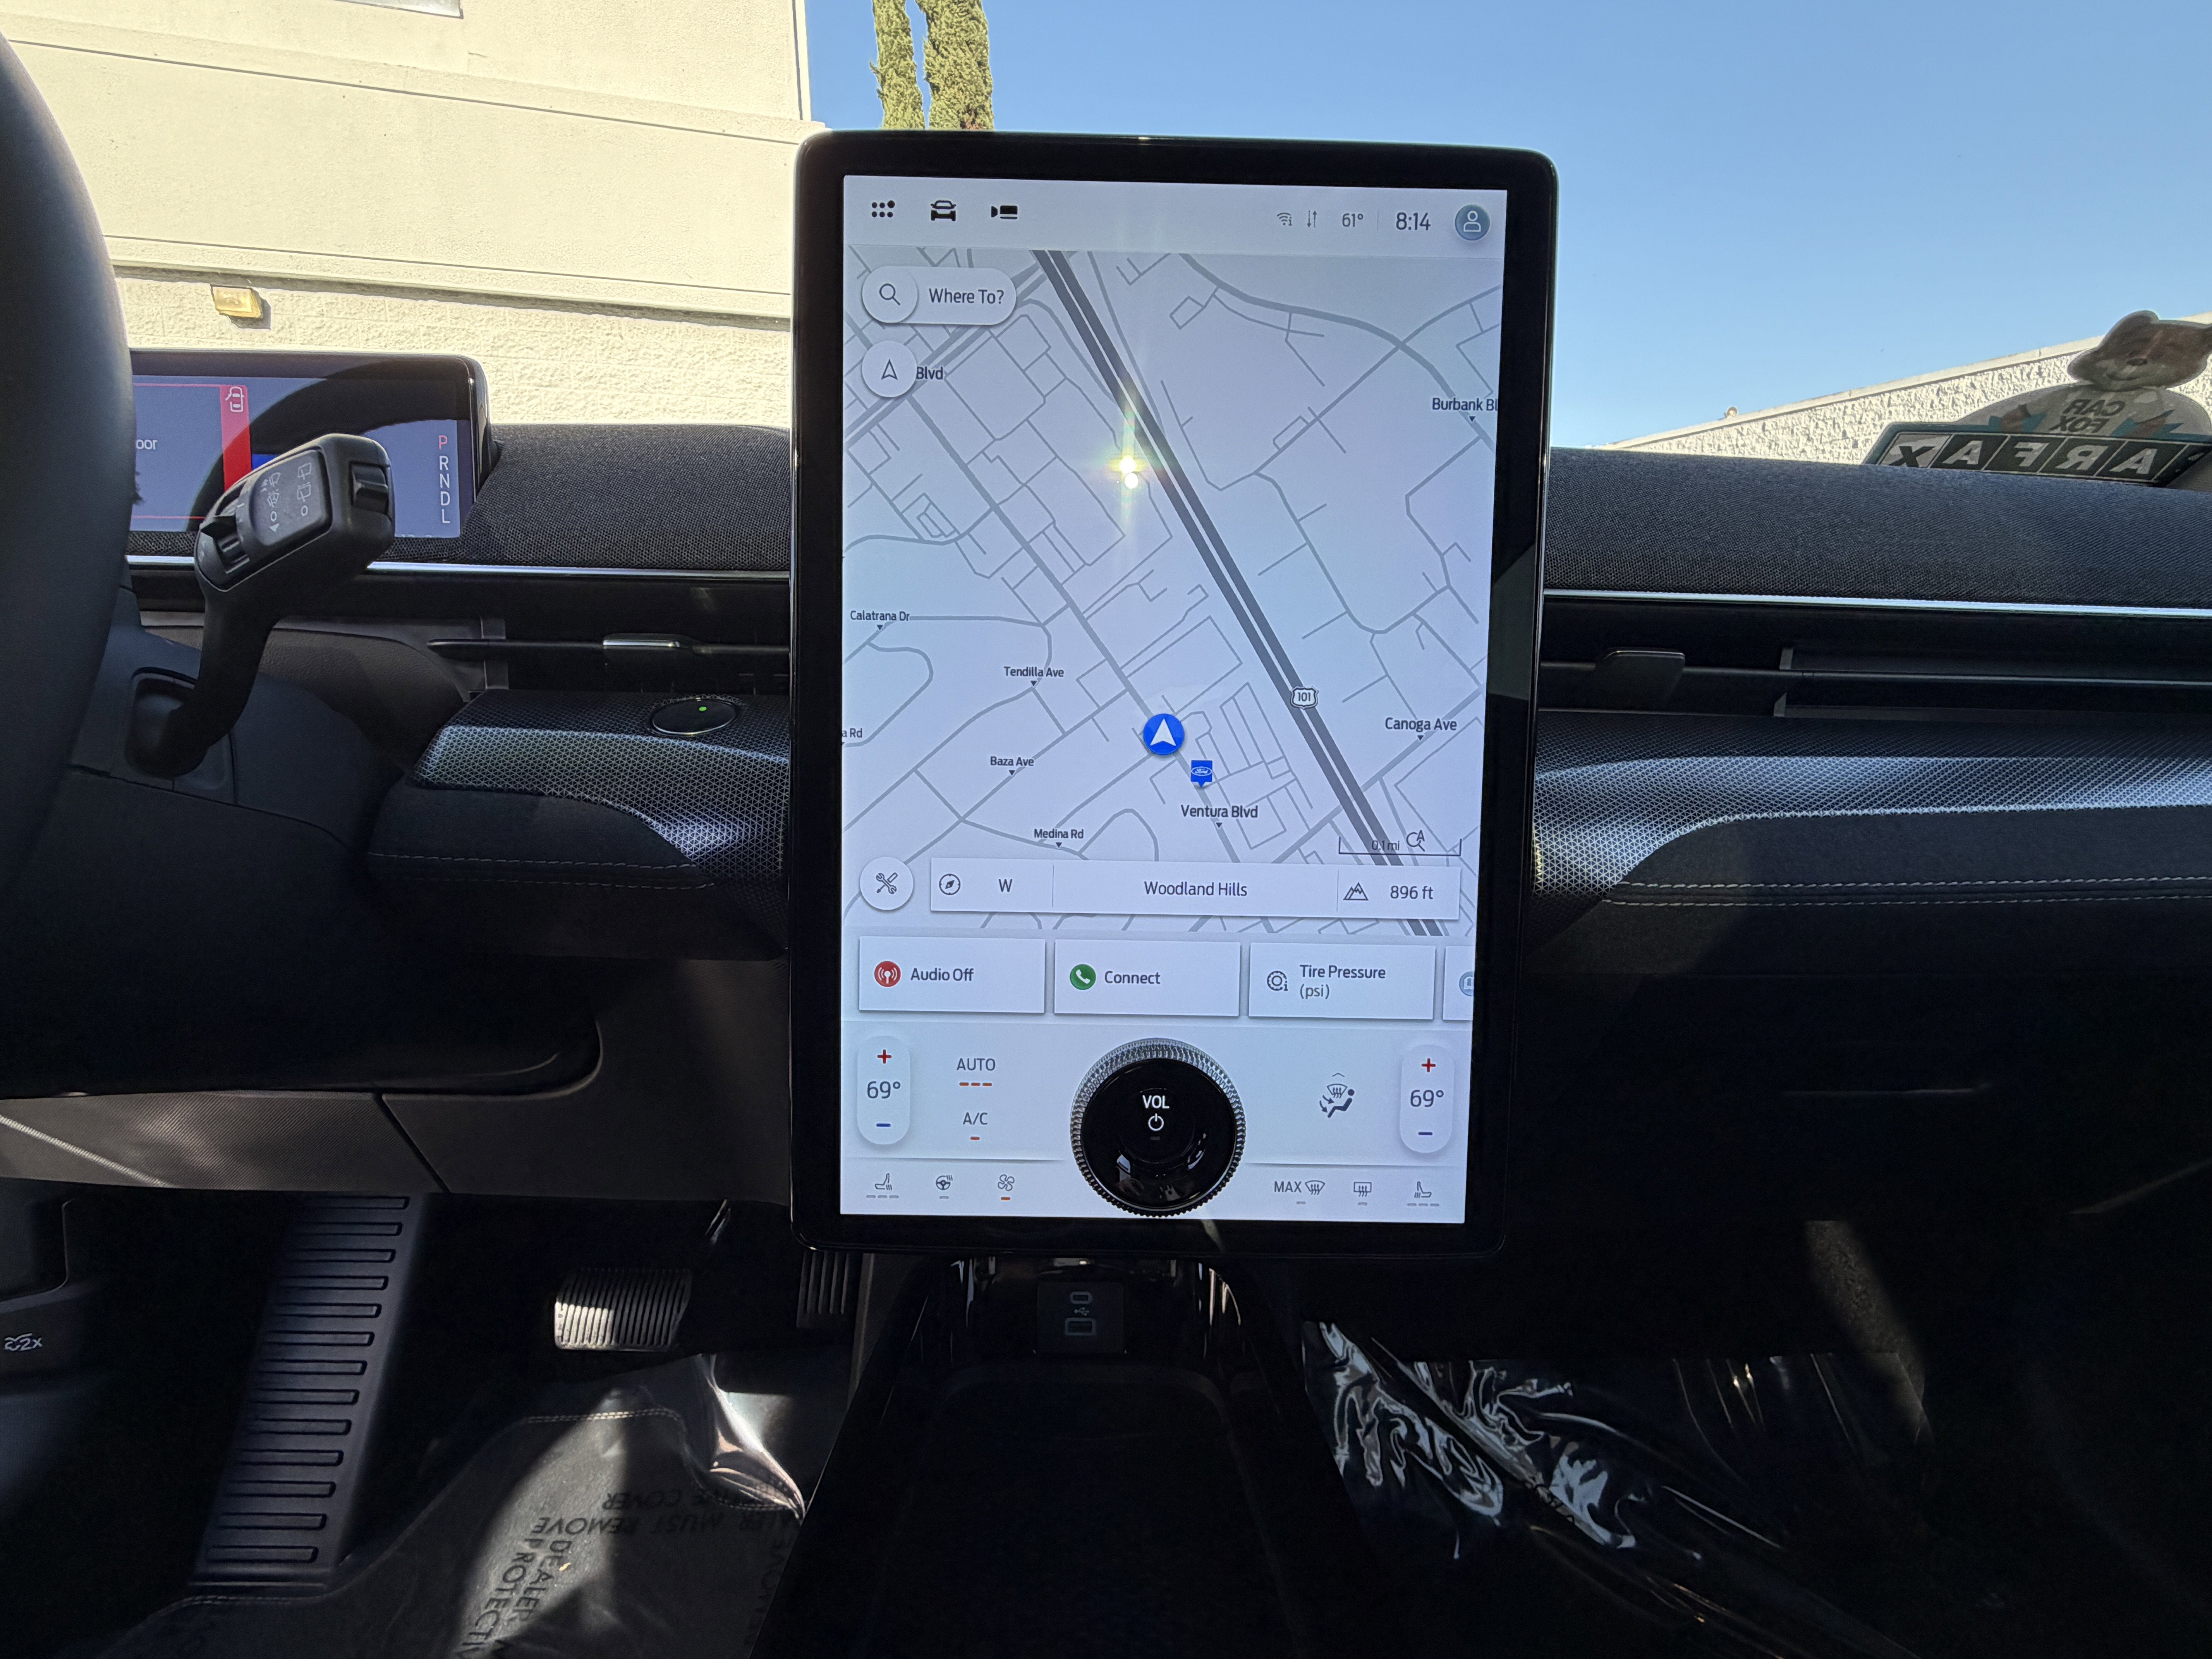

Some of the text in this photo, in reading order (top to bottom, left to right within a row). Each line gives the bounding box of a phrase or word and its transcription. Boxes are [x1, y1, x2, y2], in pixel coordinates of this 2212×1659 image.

[1342, 213, 1364, 227] 61°
[1396, 212, 1431, 231] 8:14
[929, 288, 1004, 304] Where To?
[915, 366, 943, 380] Blvd
[1432, 397, 1498, 411] Burbank Bl
[136, 439, 158, 450] oor
[438, 434, 448, 450] P
[439, 455, 449, 471] R
[440, 473, 450, 488] N
[440, 491, 451, 506] D
[441, 508, 450, 524] L
[850, 610, 910, 621] Calatrana Dr
[1003, 666, 1064, 677] Tendilla Ave
[1297, 692, 1311, 702] 101
[1385, 717, 1457, 733] Canoga Ave
[850, 728, 862, 738] Rd
[990, 756, 1034, 766] Baza Ave
[1180, 805, 1258, 818] Ventura Blvd
[1034, 828, 1084, 839] Medina Rd
[1371, 840, 1400, 850] 0.1 mi
[998, 879, 1013, 892] W
[1144, 881, 1247, 896] Woodland Hills
[1390, 885, 1434, 900] 896 ft
[910, 967, 974, 981] Audio Off
[1104, 970, 1161, 984] Connect
[1299, 964, 1386, 979] Tire Pressure
[1300, 984, 1330, 1000] (psi)
[957, 1058, 996, 1071] AUTO
[867, 1081, 901, 1099] 69°
[1142, 1095, 1170, 1109] VOL
[1410, 1089, 1444, 1108] 69°
[963, 1112, 988, 1125] A/C
[1274, 1181, 1302, 1193] MAX
[531, 1517, 639, 1536] REMOVE
[507, 1540, 572, 1623] DEALER
[456, 1538, 544, 1659] PROTECTIV
